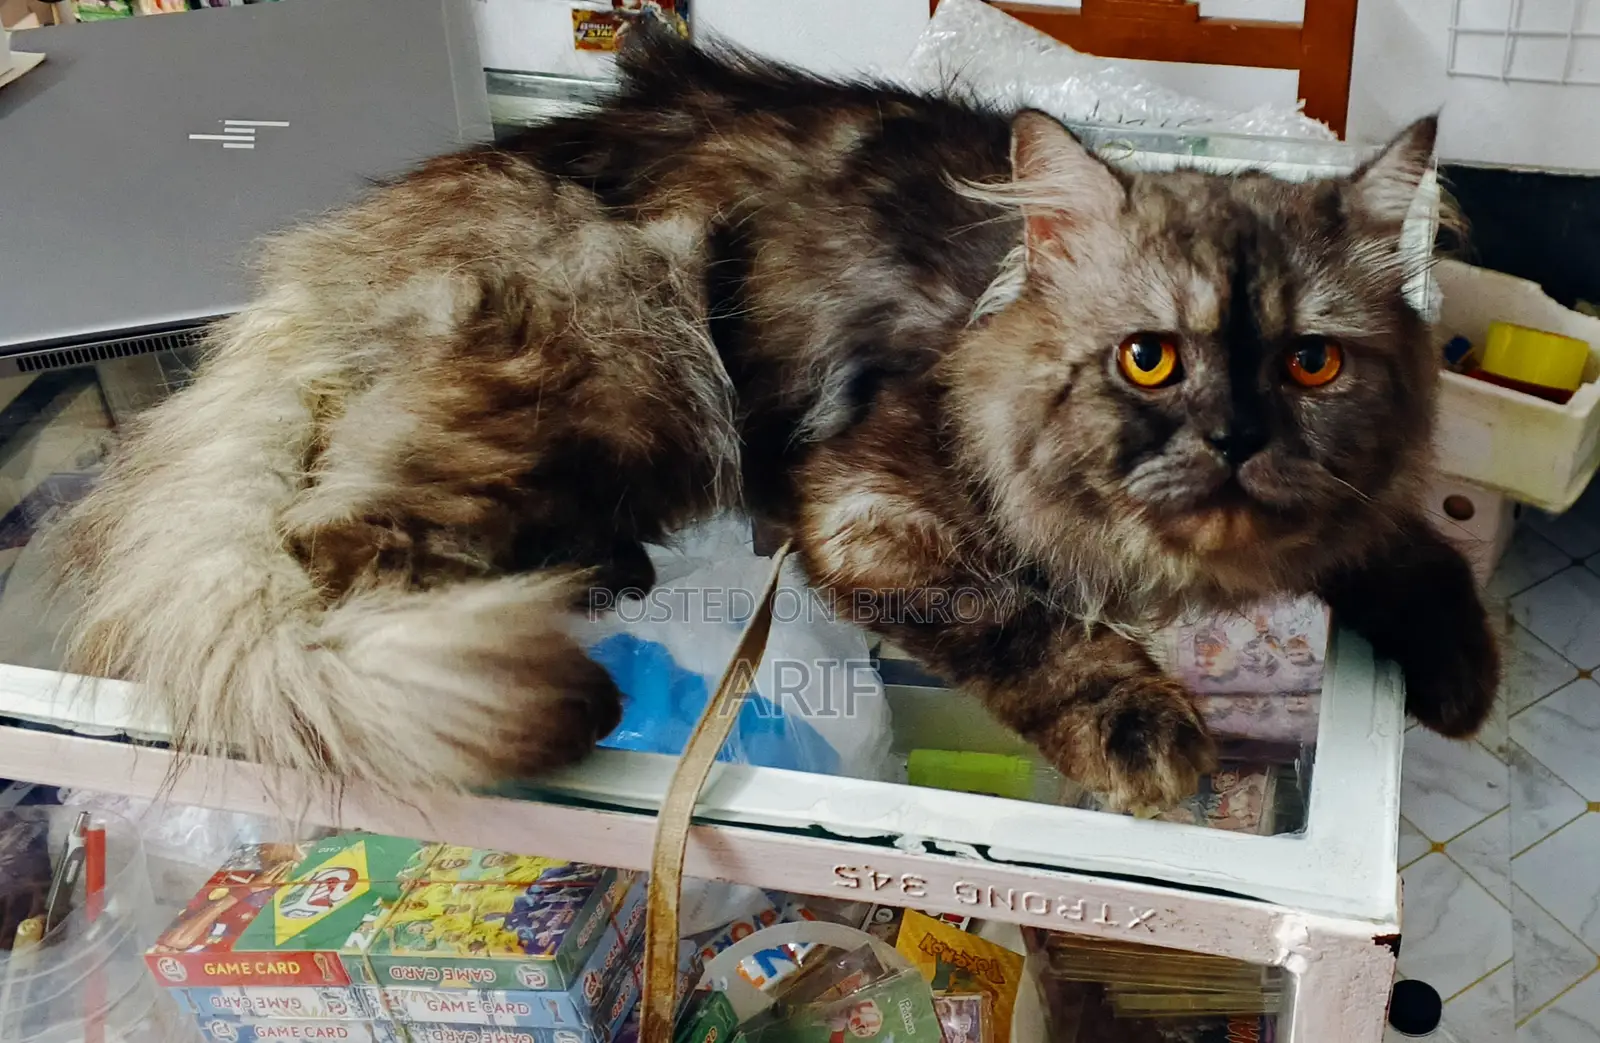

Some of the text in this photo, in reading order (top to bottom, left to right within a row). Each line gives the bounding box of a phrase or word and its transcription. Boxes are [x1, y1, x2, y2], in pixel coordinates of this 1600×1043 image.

[953, 879, 1158, 934] XTRONG
[204, 961, 301, 976] GAME CARD
[389, 965, 496, 982] GAME CARD
[209, 995, 302, 1010] GAME CARD
[427, 999, 530, 1016] GAME CARD
[255, 1026, 348, 1039] GAME CARD
[431, 1029, 534, 1043] GAME CARD
